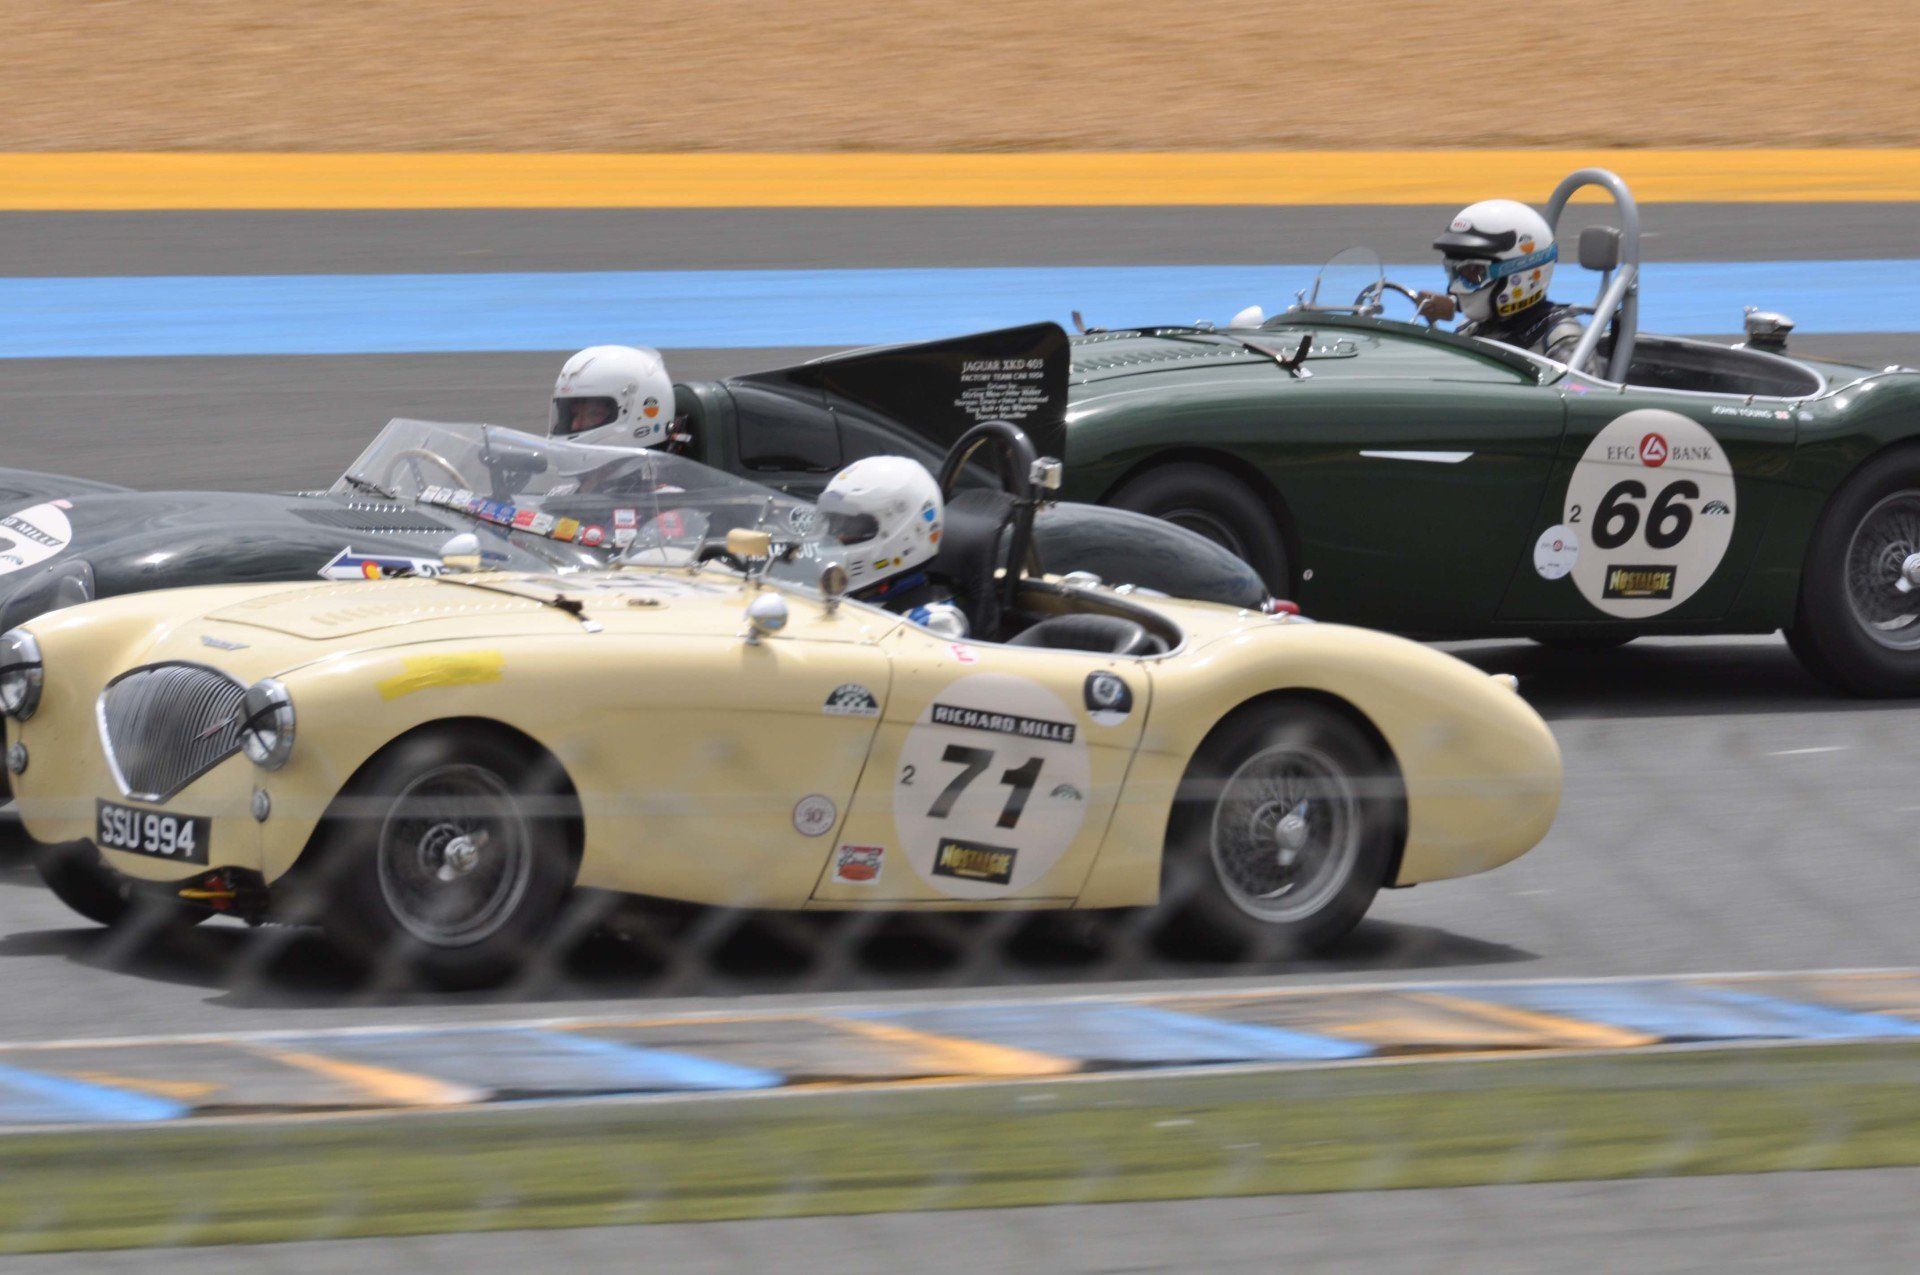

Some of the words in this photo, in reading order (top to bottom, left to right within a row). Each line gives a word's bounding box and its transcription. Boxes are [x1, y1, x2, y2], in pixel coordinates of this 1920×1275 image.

[961, 360, 1000, 374] JAGUAR
[1002, 359, 1025, 370] XKD
[1607, 446, 1635, 460] EFG
[1672, 446, 1713, 461] BANK
[1569, 504, 1581, 522] 2
[1591, 479, 1699, 549] 66
[1609, 567, 1672, 591] NOSTALGIE
[935, 706, 1015, 732] RICHARD
[1019, 723, 1074, 741] MILLE
[900, 764, 916, 785] 2
[926, 744, 1045, 829] 71
[102, 805, 140, 848] SSU
[144, 814, 196, 857] 994
